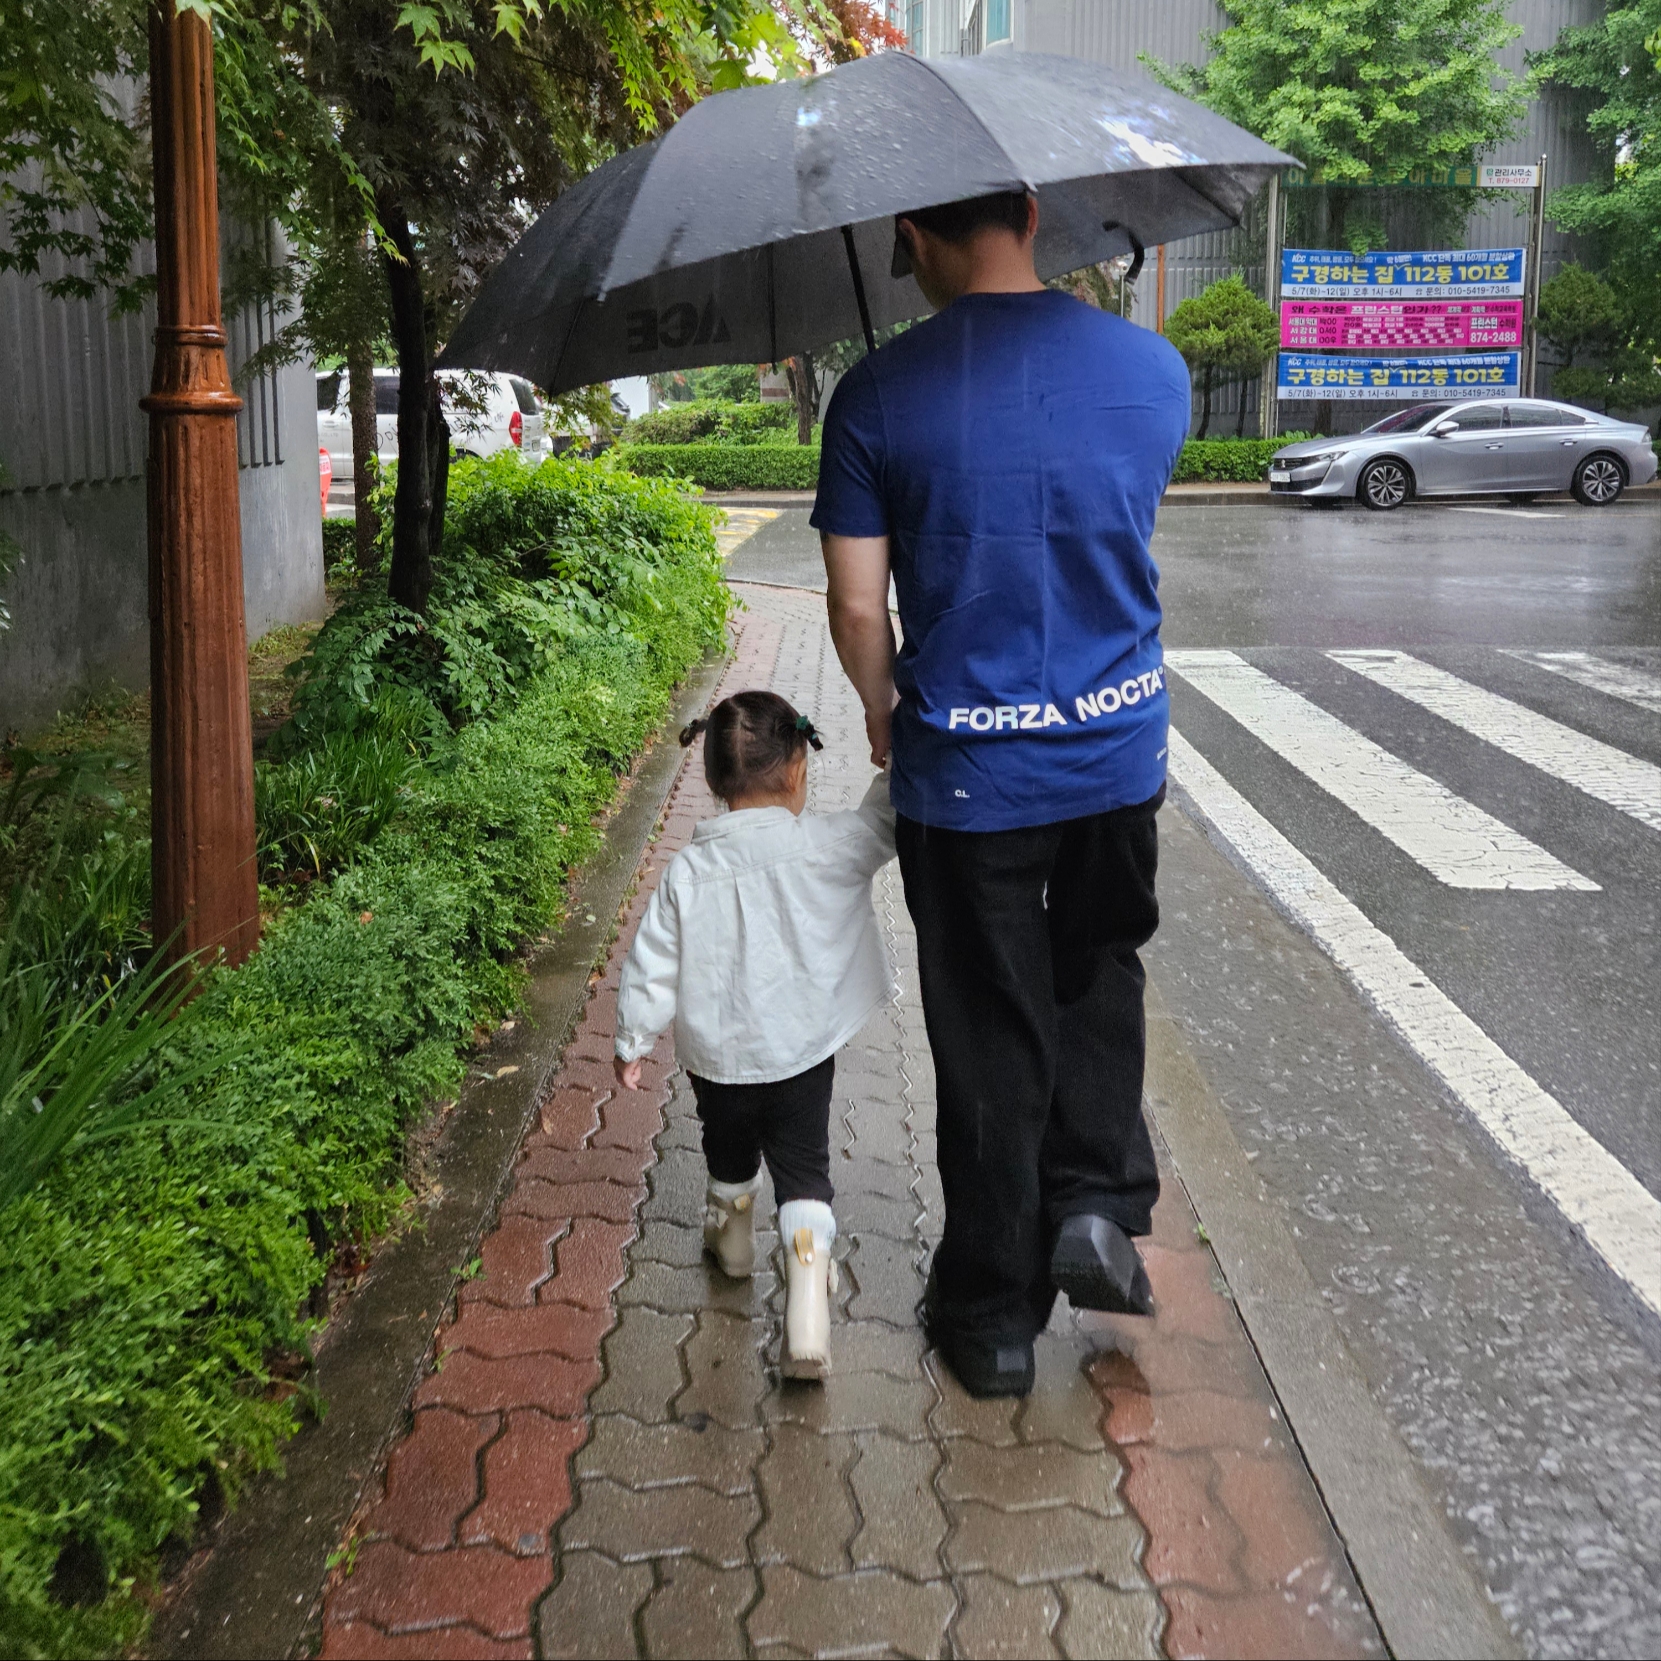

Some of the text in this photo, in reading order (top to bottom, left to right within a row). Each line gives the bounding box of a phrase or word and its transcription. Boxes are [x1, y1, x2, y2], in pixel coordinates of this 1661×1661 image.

[1494, 168, 1532, 177] 관리사무소
[1292, 254, 1306, 263] KCC
[1422, 254, 1437, 262] KCC
[1291, 263, 1510, 284] 구경하는 집 112동 101호
[1353, 288, 1368, 296] 오후
[1372, 287, 1402, 296] 1시~6시
[1426, 287, 1445, 296] 문의:
[1448, 286, 1510, 295] 010-5419-7345
[1292, 306, 1304, 314] 왜
[1309, 306, 1347, 314] 수학은
[1471, 317, 1498, 329] 프린스턴
[1470, 331, 1517, 343] 874-2488
[1288, 358, 1302, 366] KCC
[1287, 367, 1505, 386] 구경하는 집 112동 101호
[1288, 388, 1506, 398] 5/7(화)~12(일) 오후 1시~6시 문의: 010-5419-7345
[948, 702, 1068, 731] FORZA
